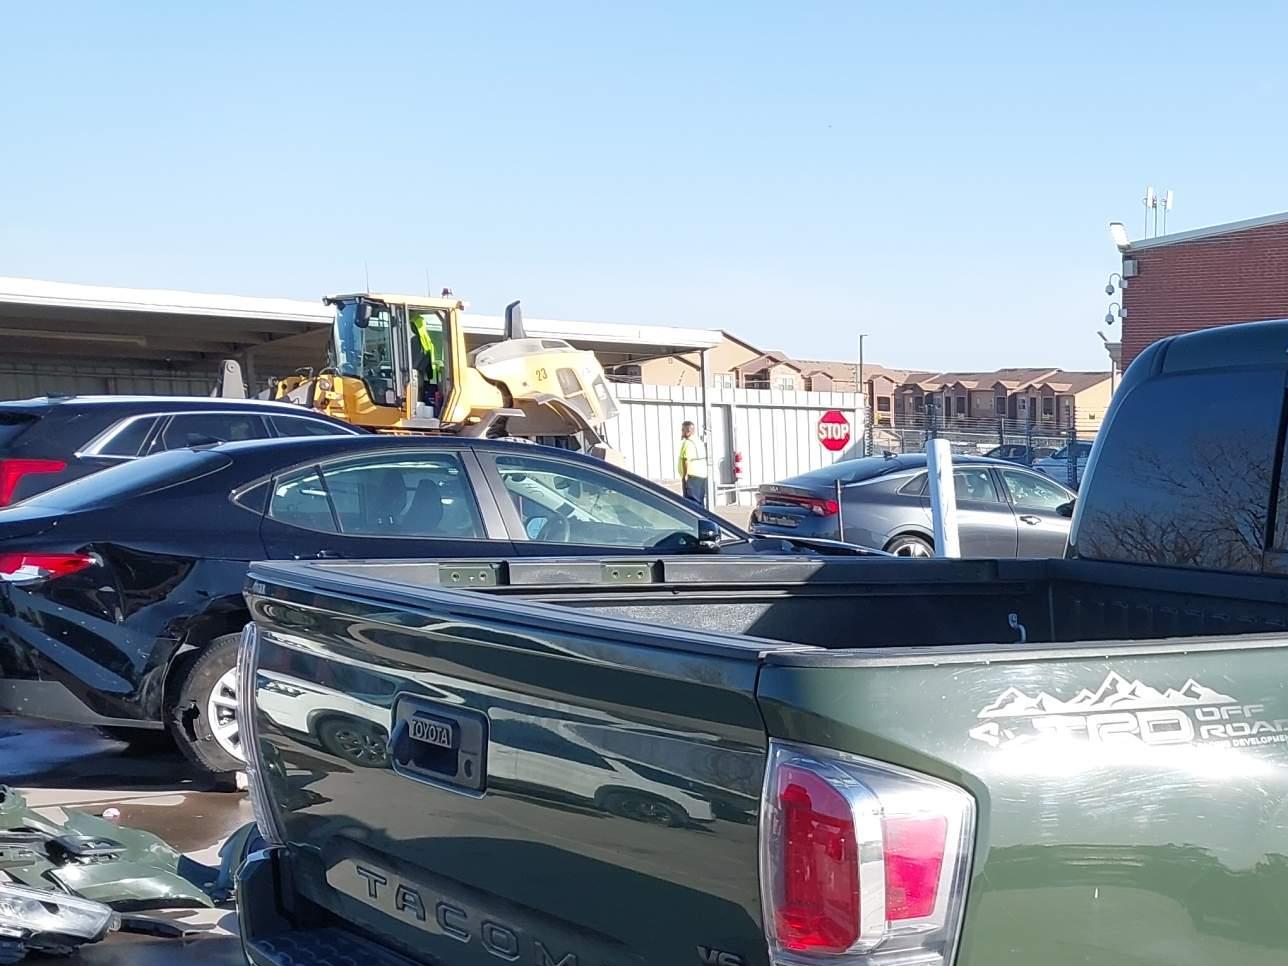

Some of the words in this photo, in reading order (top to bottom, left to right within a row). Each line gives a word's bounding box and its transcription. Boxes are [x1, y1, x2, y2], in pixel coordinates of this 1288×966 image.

[535, 367, 549, 382] 23
[818, 422, 849, 440] STOP
[1194, 704, 1265, 721] OFF
[409, 718, 450, 746] TOYOTA
